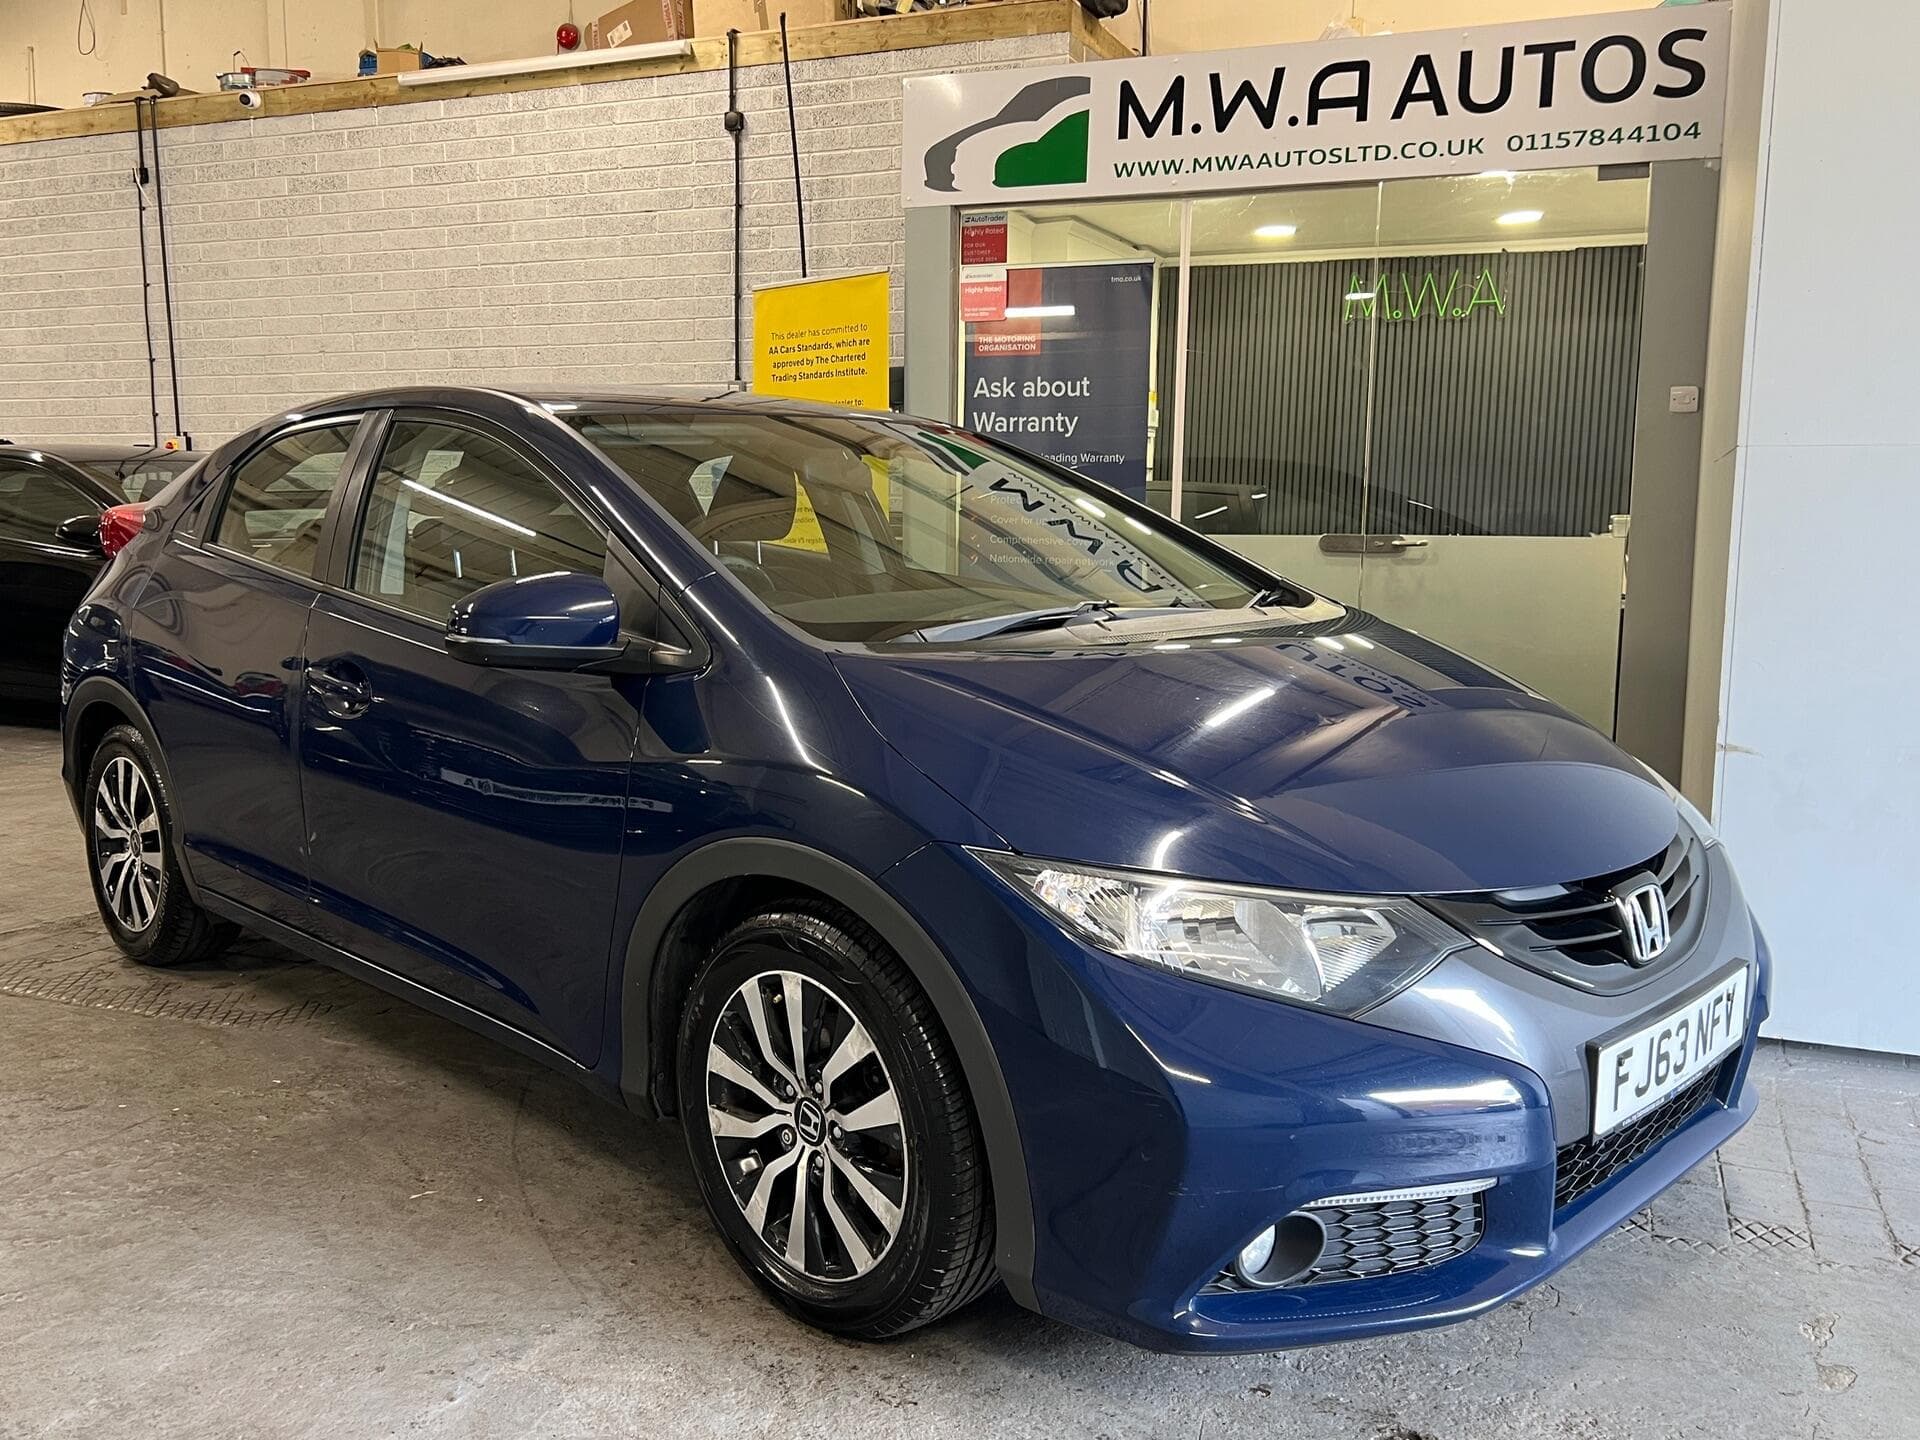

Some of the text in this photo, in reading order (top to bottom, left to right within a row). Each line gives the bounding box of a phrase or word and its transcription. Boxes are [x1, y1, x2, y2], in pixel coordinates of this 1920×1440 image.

[1118, 28, 1707, 140] M.W.A AUTOS
[1114, 121, 1702, 178] WWW.MWAAUTOSLTD.CO.UK 01157844104
[1344, 268, 1504, 322] M.W.A
[771, 323, 868, 341] This dealer has committed to
[978, 334, 1036, 344] THE MOTORING
[768, 338, 870, 355] AA Cars Standards, which are
[978, 343, 1036, 352] ORGANISATION
[772, 352, 866, 369] approved by The Chartered
[771, 367, 868, 382] Trading Standards Institute.
[973, 376, 1090, 398] Ask about
[973, 411, 1079, 437] Warranty
[1080, 453, 1125, 464] Warranty
[1613, 982, 1737, 1112] FJ63 NFY
